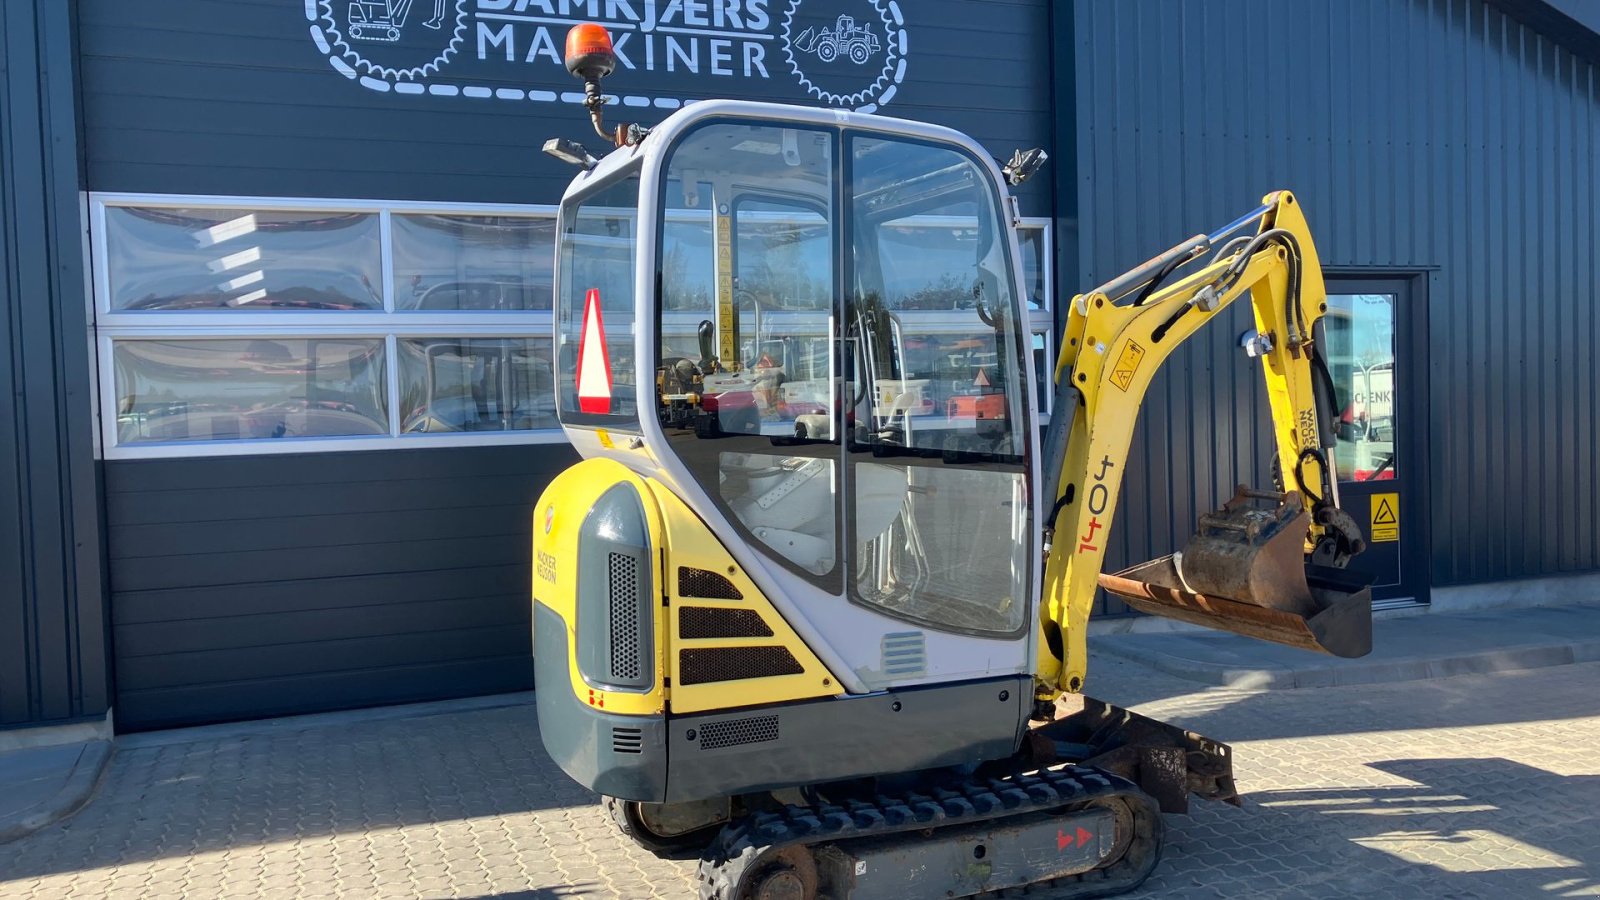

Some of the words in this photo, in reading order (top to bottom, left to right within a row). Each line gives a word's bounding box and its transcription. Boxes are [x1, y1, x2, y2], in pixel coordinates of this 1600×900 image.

[477, 0, 770, 32] KJÆRS
[476, 22, 770, 78] MAKINER
[1079, 455, 1114, 553] 1404
